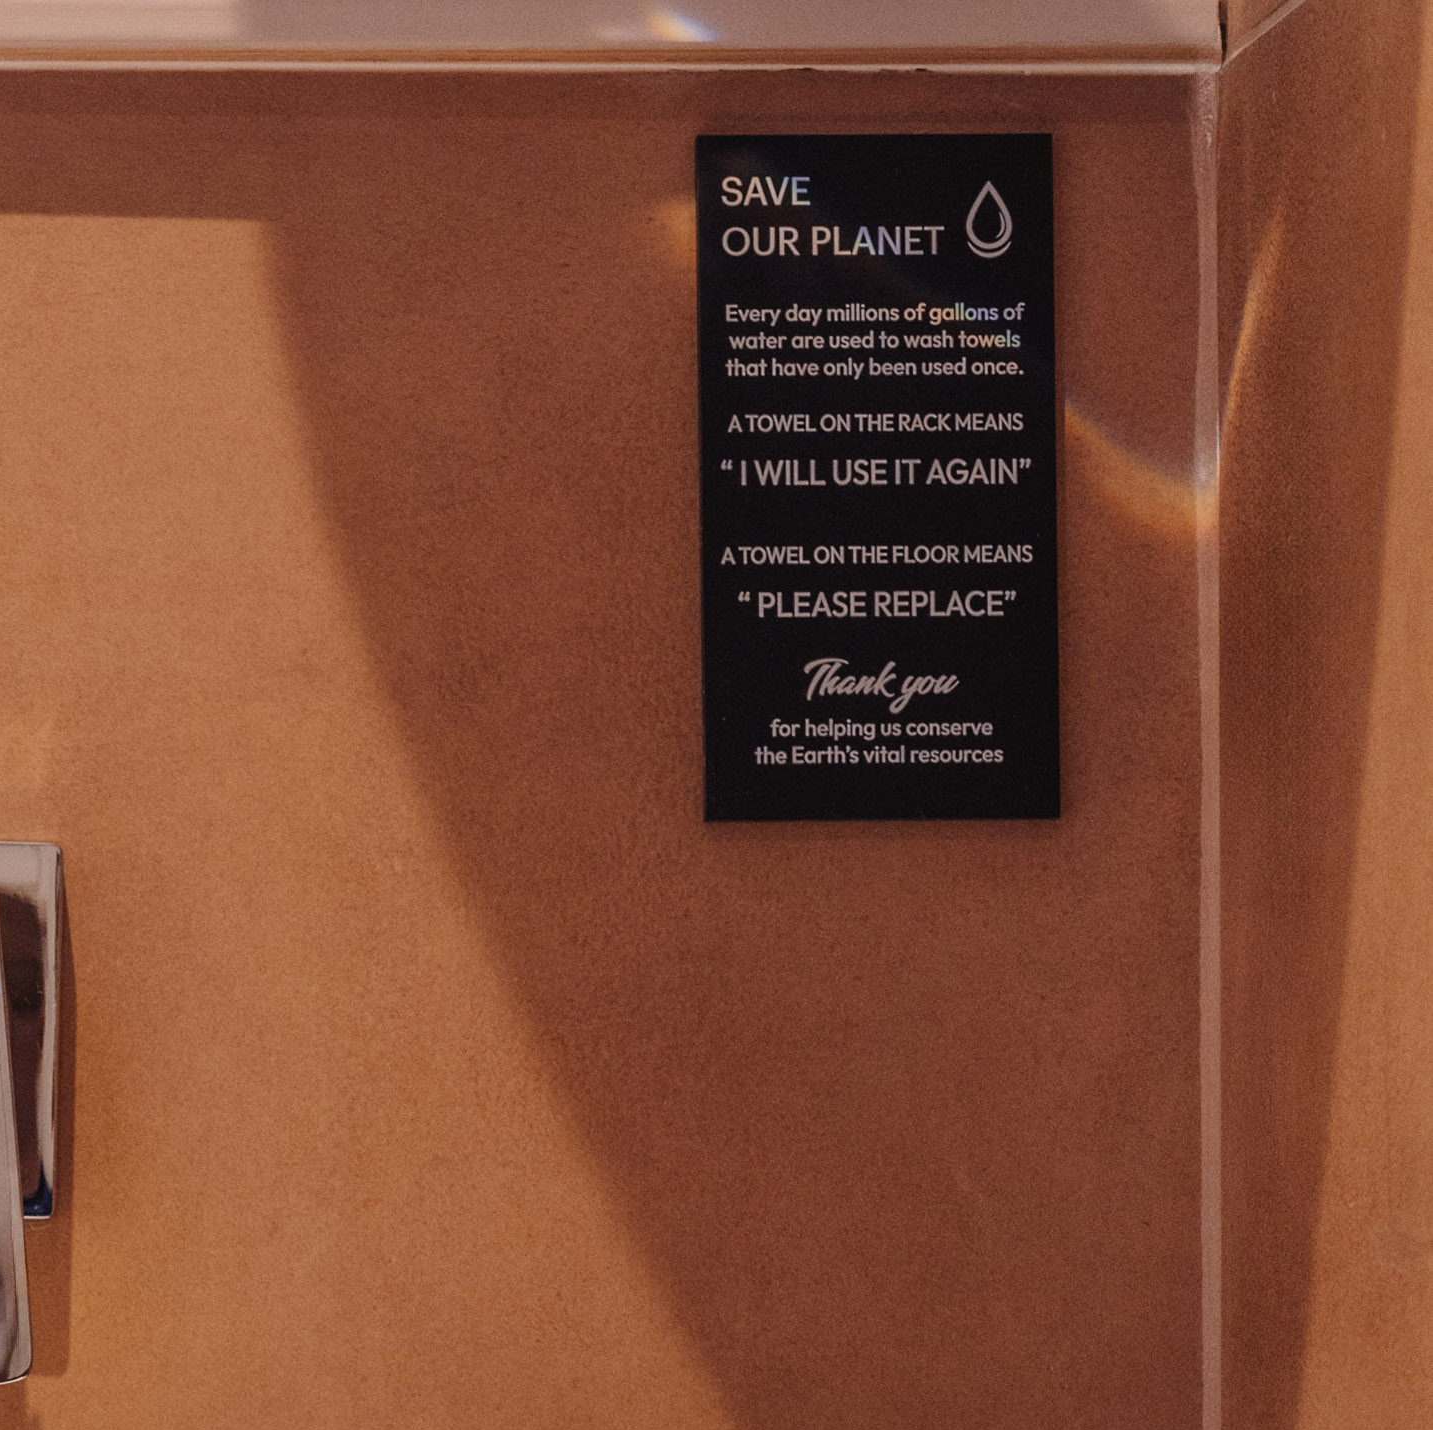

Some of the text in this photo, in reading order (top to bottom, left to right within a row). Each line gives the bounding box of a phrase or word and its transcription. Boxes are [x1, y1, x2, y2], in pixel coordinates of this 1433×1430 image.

[720, 175, 812, 207] SAVE
[721, 225, 945, 257] OUR PLANET
[725, 301, 1026, 327] Every day millions of gallons of
[728, 328, 1022, 350] water are used to wash towels
[724, 356, 1025, 381] that have only been used once.
[727, 412, 1025, 433] A TOWEL ON THE RACK MEANS
[753, 459, 827, 486] WILL
[832, 458, 888, 486] USE
[894, 458, 922, 486] IT
[720, 544, 1034, 566] A TOWEL ON THE FLOOR MEANS
[803, 657, 961, 715] Thank you
[769, 717, 994, 742] for helping us conserve
[754, 744, 1004, 765] the Earth’s vital resources
